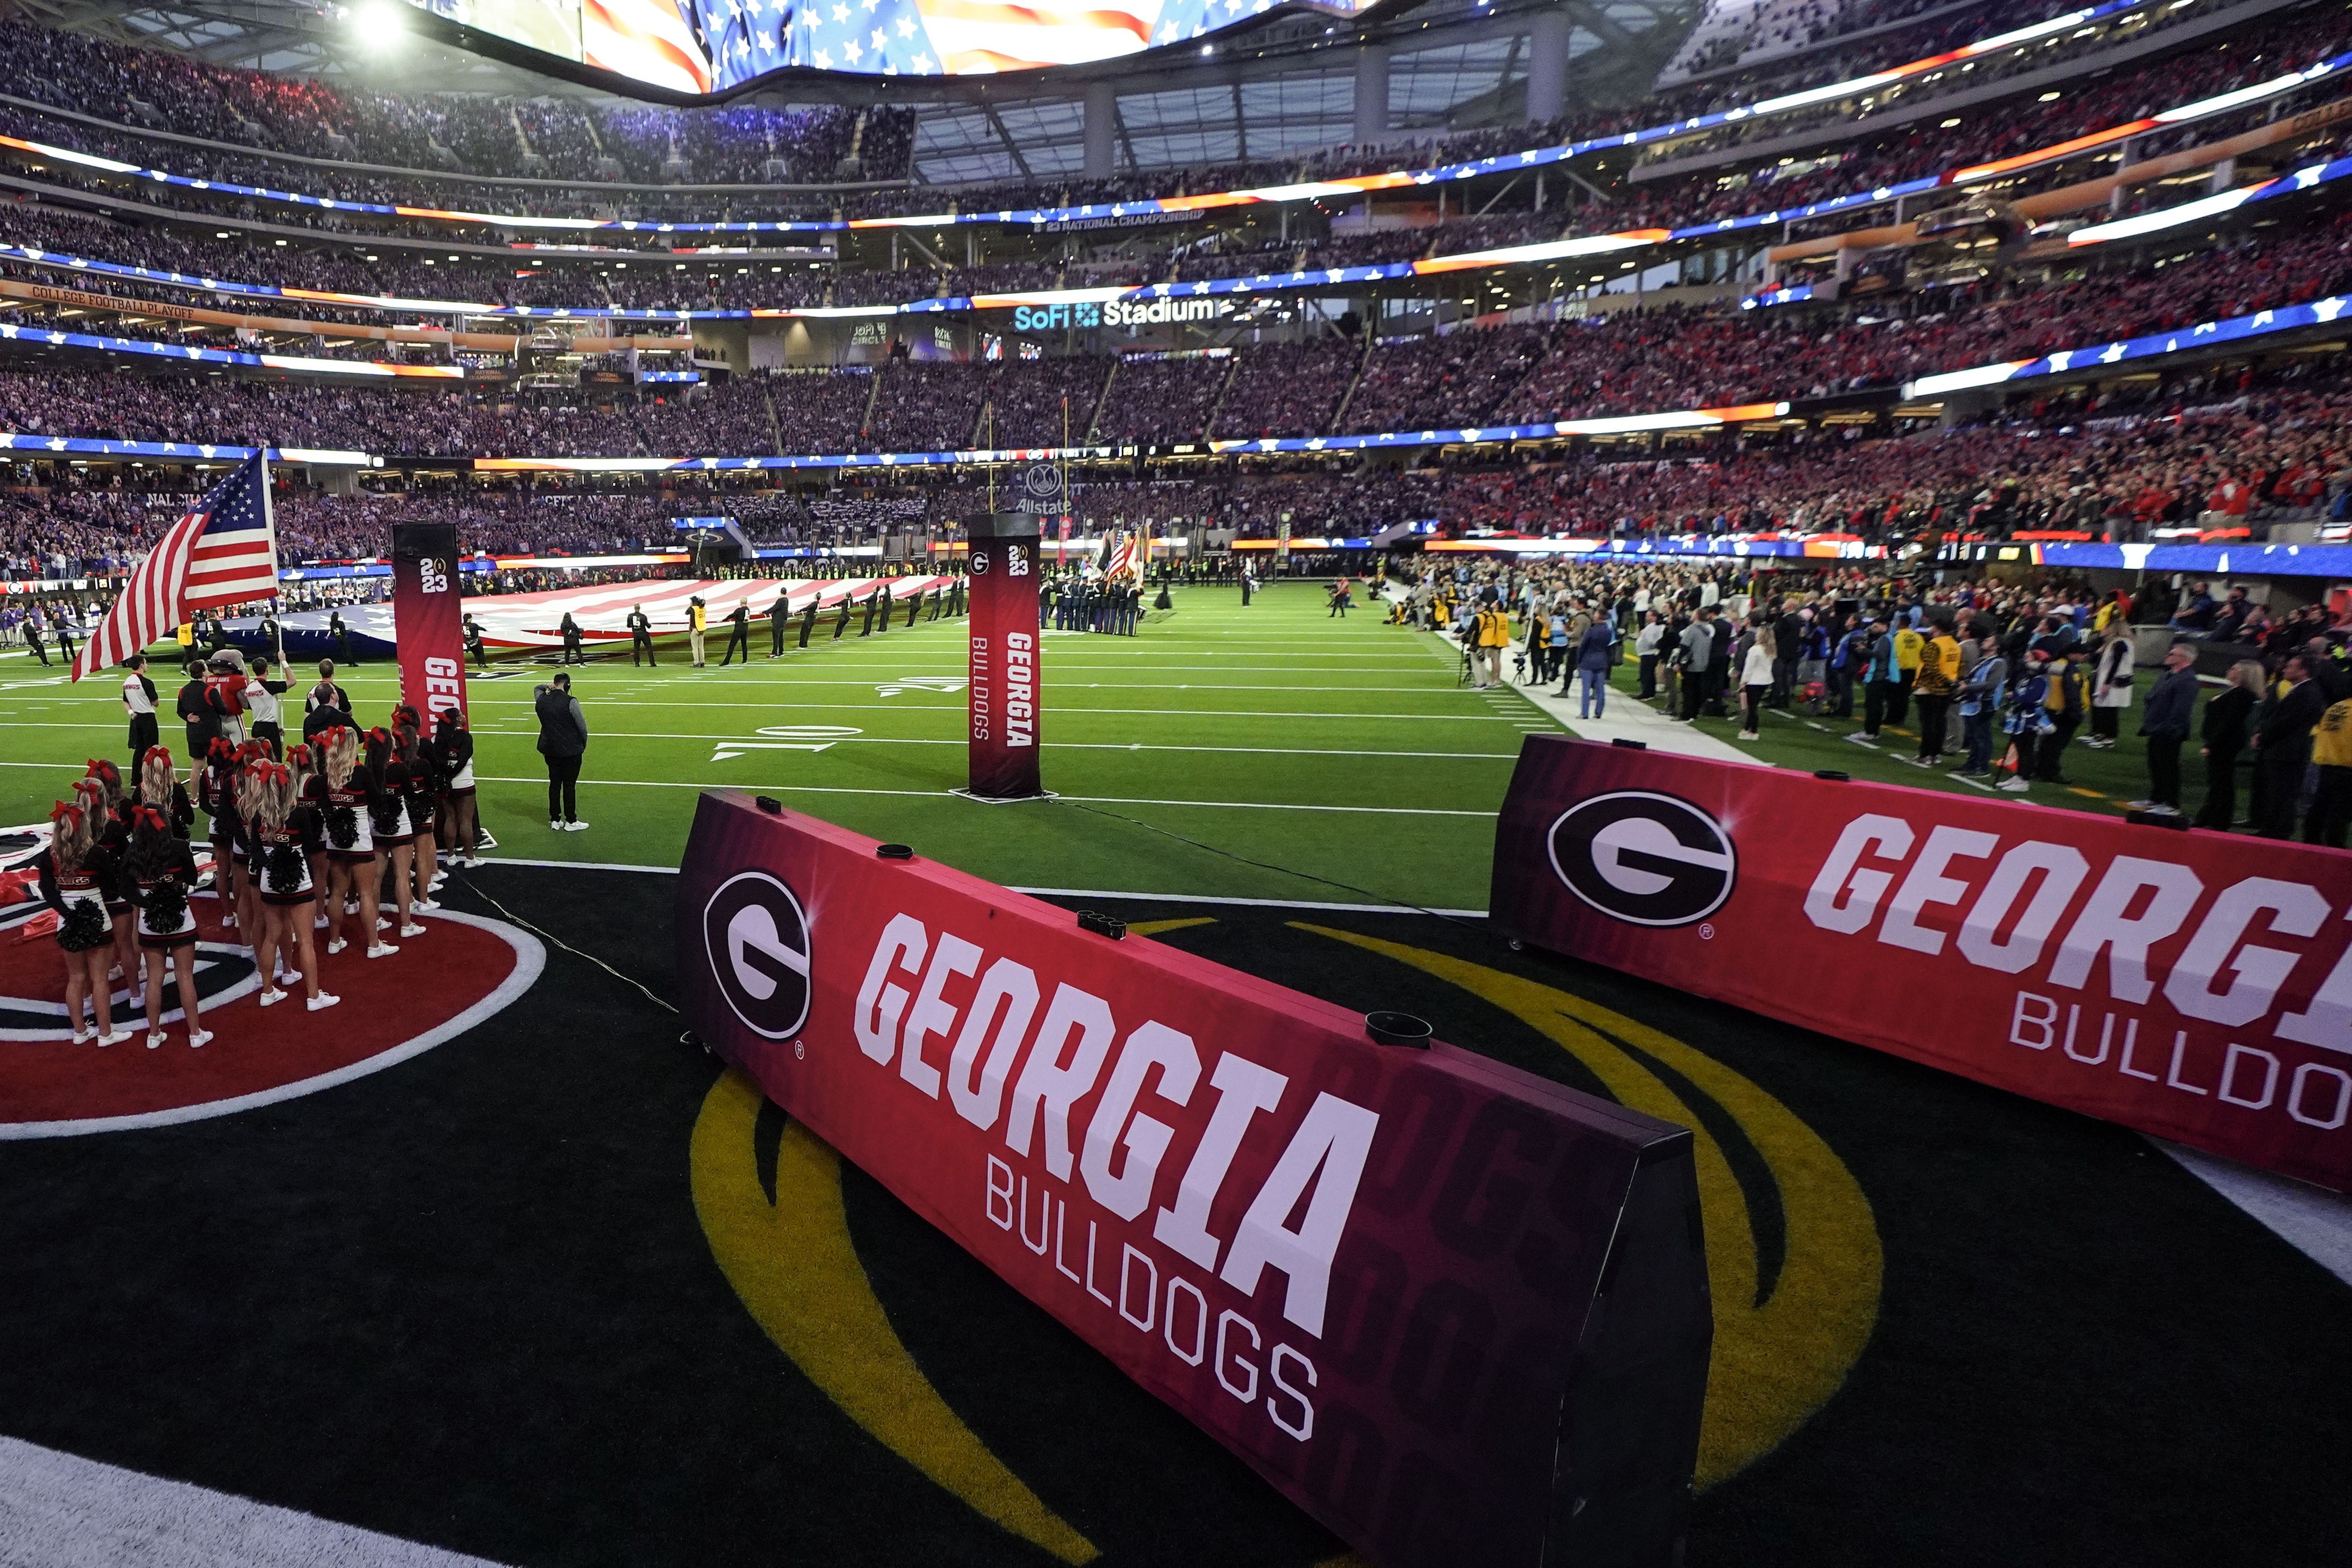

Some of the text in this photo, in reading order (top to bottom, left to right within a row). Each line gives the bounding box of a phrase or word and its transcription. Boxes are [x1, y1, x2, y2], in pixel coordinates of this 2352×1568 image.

[32, 286, 194, 319] COLLEGE FOOTBALL PLAYOFF
[1015, 296, 1214, 330] SoFi Stadium
[1017, 497, 1073, 515] Allstate
[421, 574, 448, 594] 23
[1009, 560, 1029, 576] 23
[972, 637, 989, 740] BULLDOGS
[1007, 632, 1032, 747] GEORGIA
[853, 912, 1380, 1339] GEORGIA
[986, 1152, 1318, 1443] BULLDOGS
